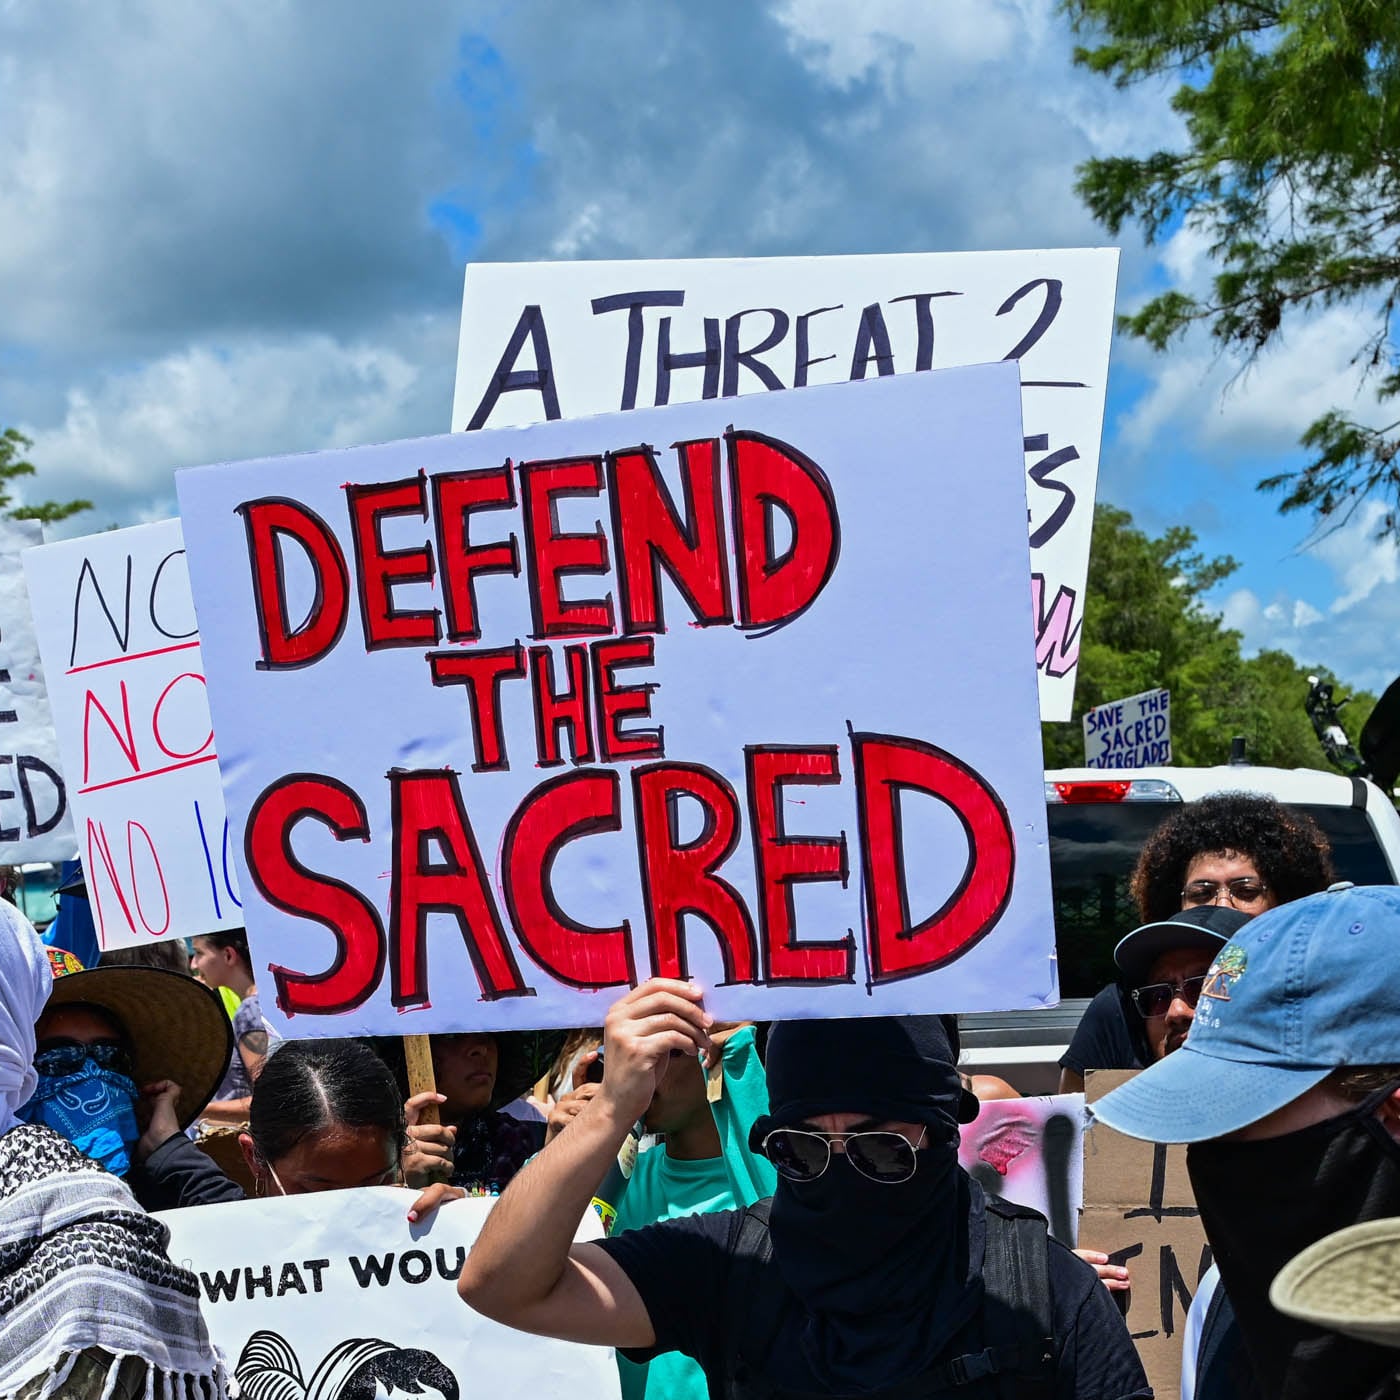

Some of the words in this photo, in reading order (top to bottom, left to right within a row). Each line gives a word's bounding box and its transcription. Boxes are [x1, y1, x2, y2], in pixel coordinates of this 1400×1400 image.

[466, 305, 561, 431] A
[591, 289, 964, 410] THREAT
[235, 425, 841, 671] DEFEND
[84, 673, 214, 784] NO
[426, 636, 665, 773] THE
[1087, 705, 1123, 736] SAVE
[1139, 692, 1169, 716] THE
[1100, 714, 1166, 757] SACRED
[87, 817, 169, 949] NO
[243, 720, 1016, 1017] SACRED
[200, 1259, 330, 1303] WHAT
